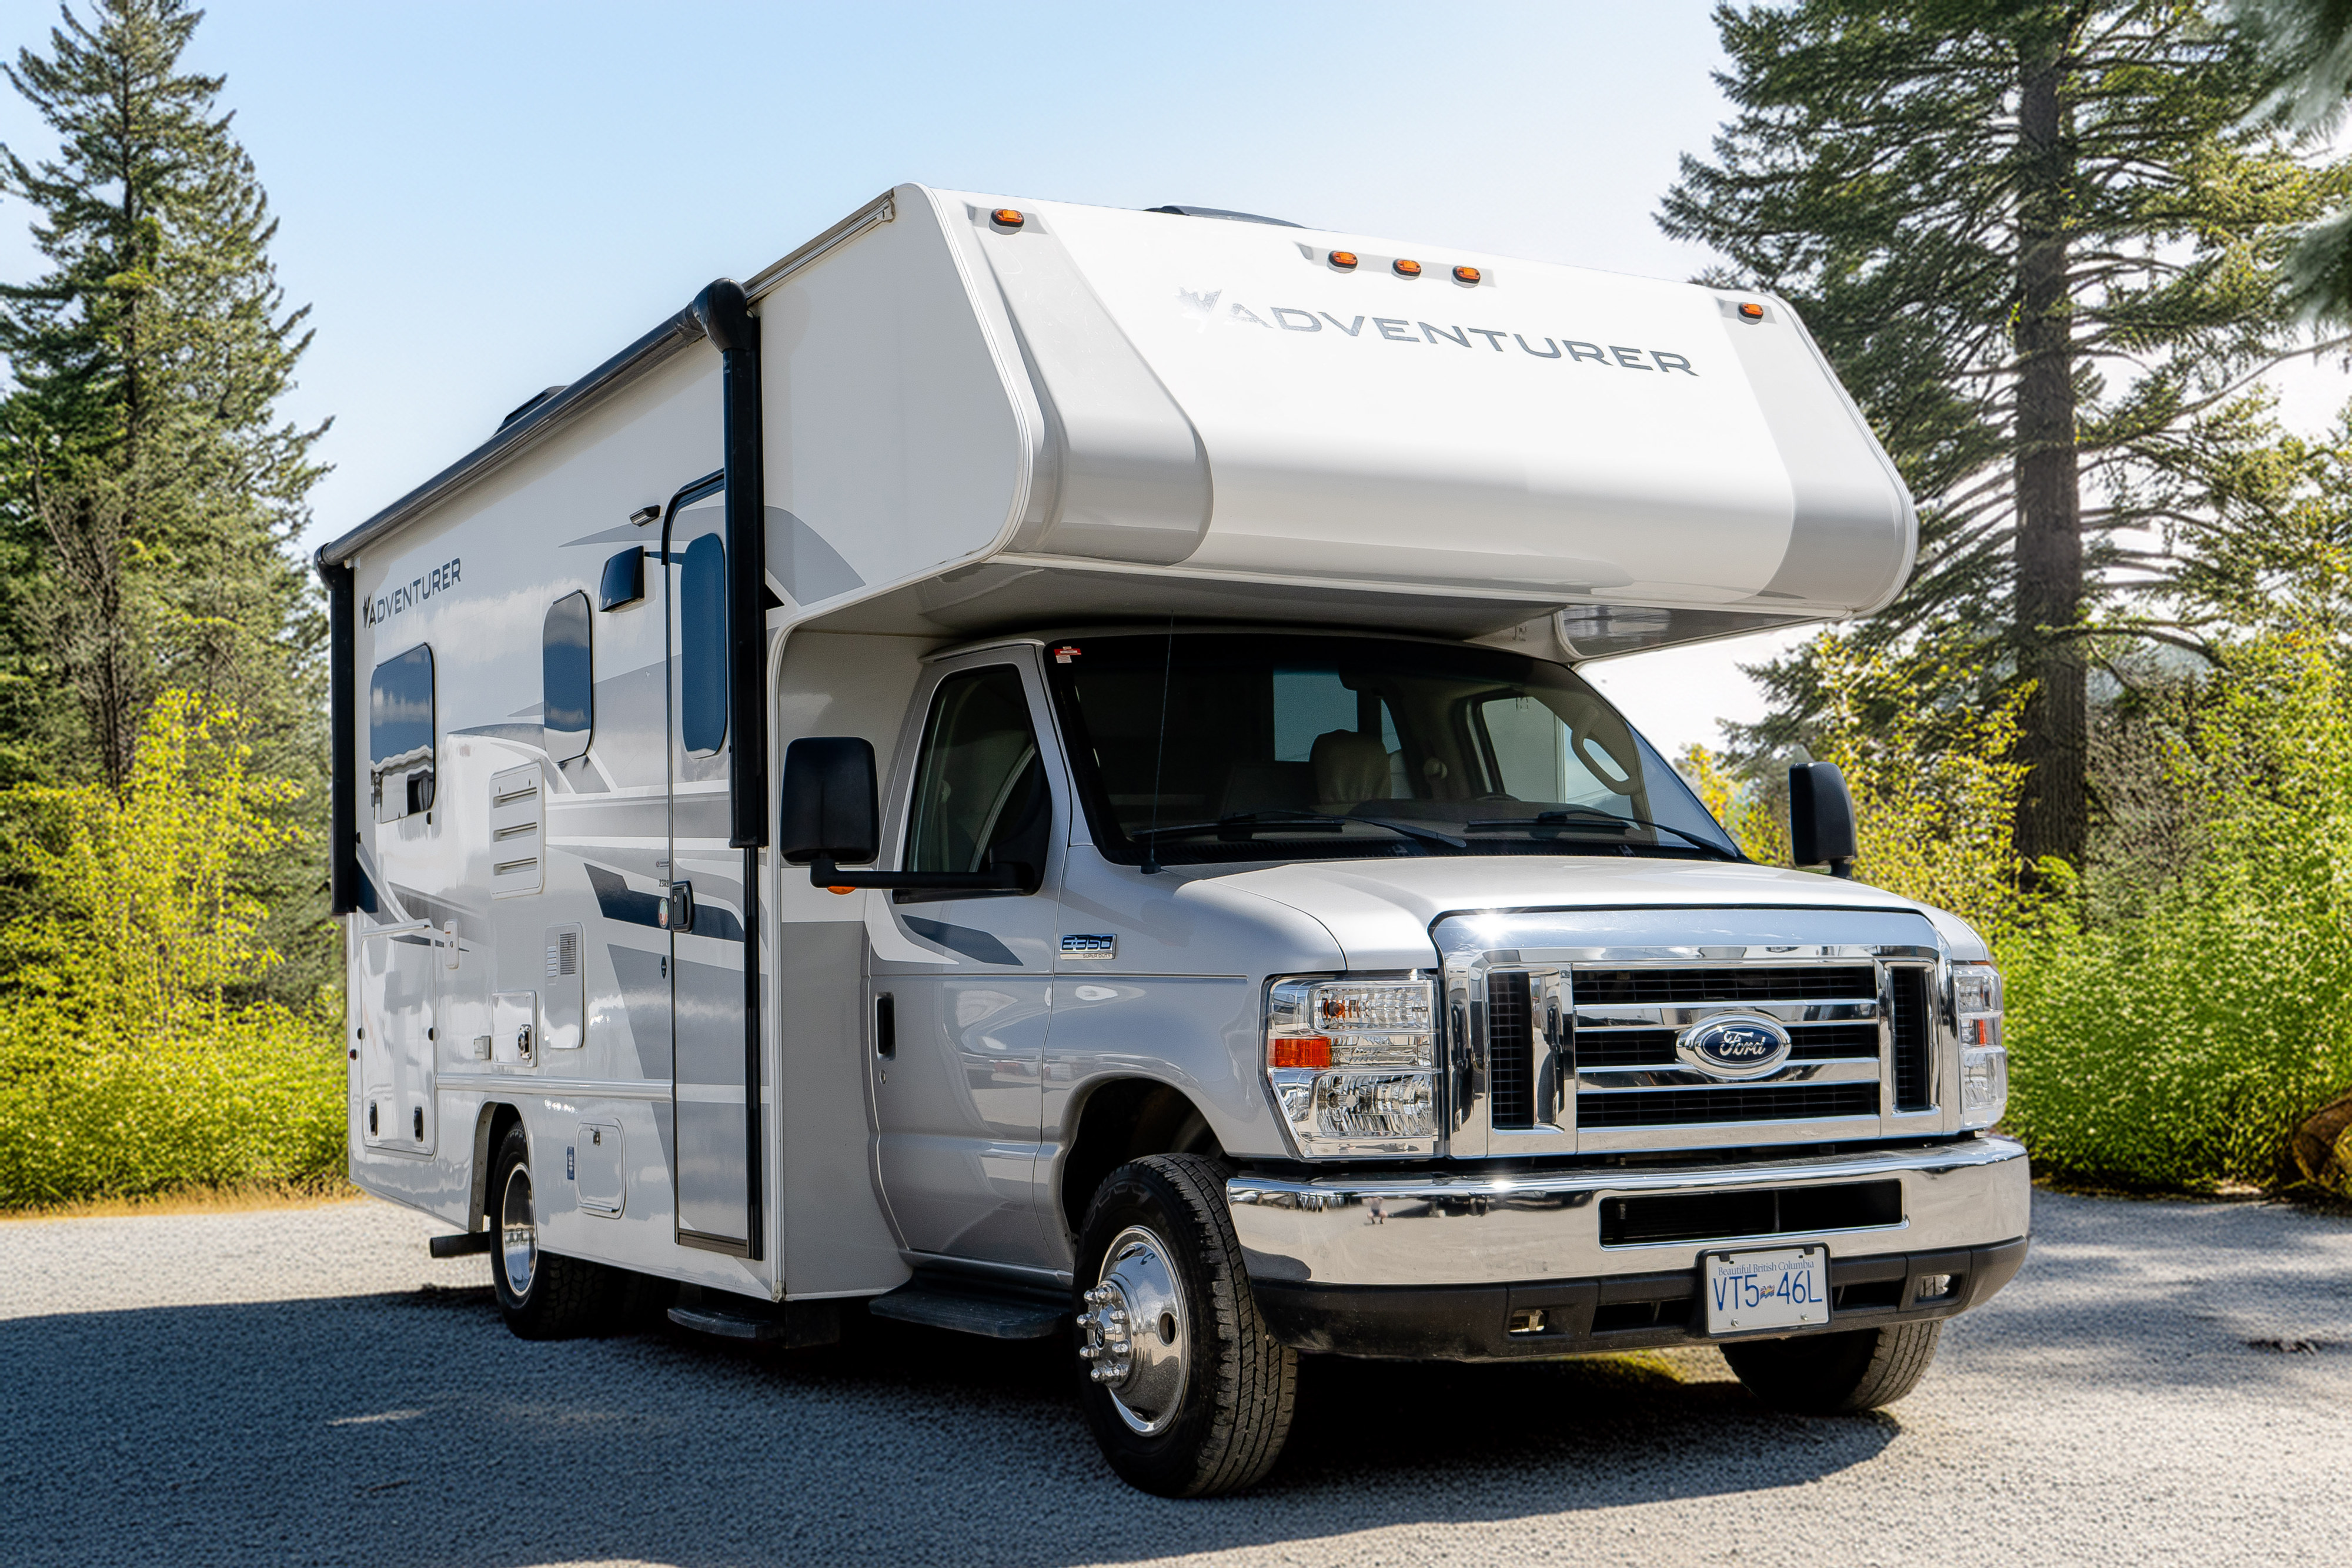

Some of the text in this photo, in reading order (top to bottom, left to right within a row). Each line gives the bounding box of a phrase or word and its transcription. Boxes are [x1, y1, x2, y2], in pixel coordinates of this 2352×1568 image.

[1227, 303, 1700, 377] ADVENTURER
[368, 557, 461, 629] ADVENTURER
[1719, 1030, 1766, 1057] Ford
[1718, 1260, 1815, 1276] Beautiful British Columbia
[1713, 1270, 1823, 1311] VT5 46L
